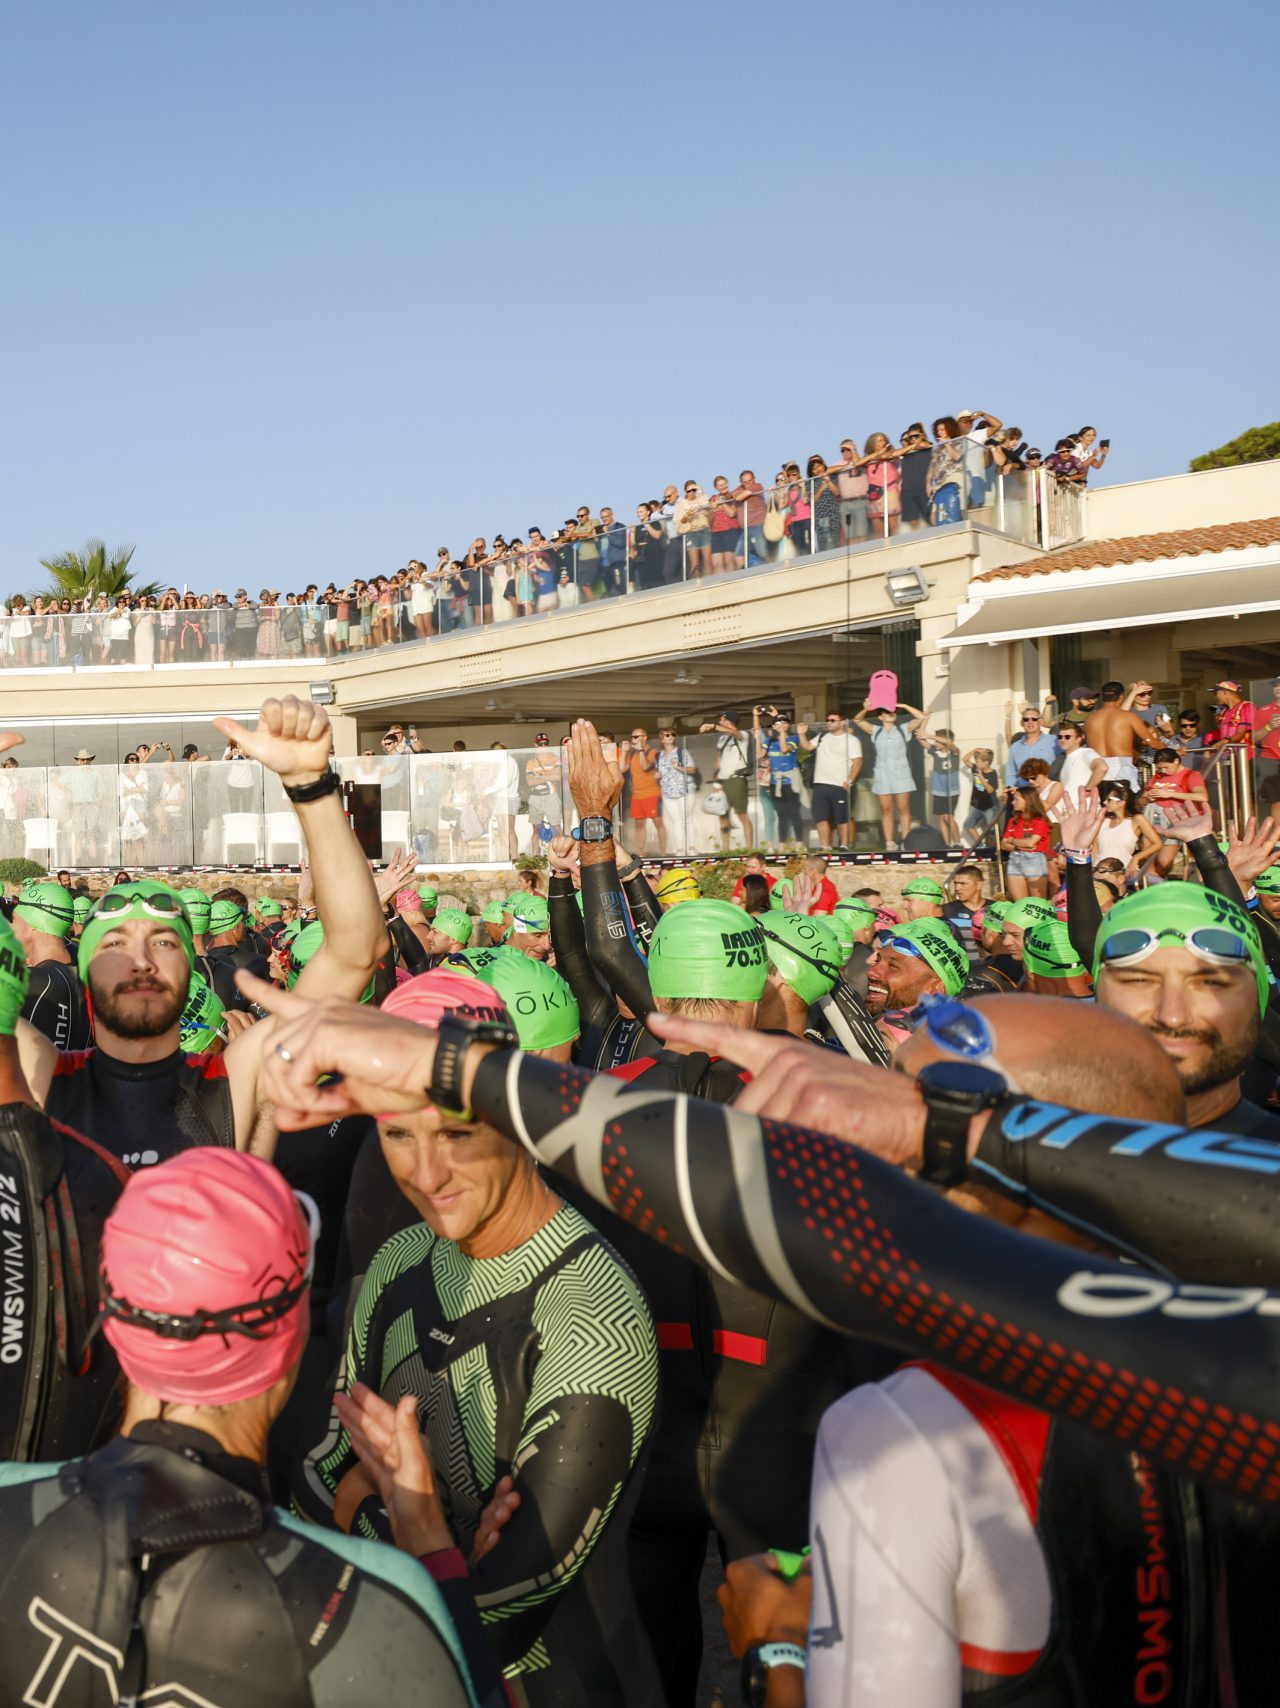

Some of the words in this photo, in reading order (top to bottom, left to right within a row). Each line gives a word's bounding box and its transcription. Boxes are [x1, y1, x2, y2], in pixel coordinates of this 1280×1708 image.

[916, 934, 942, 957] 70.3
[725, 949, 762, 968] 70.3
[0, 1229, 25, 1364] OWSWIM
[428, 1327, 456, 1346] 2XU
